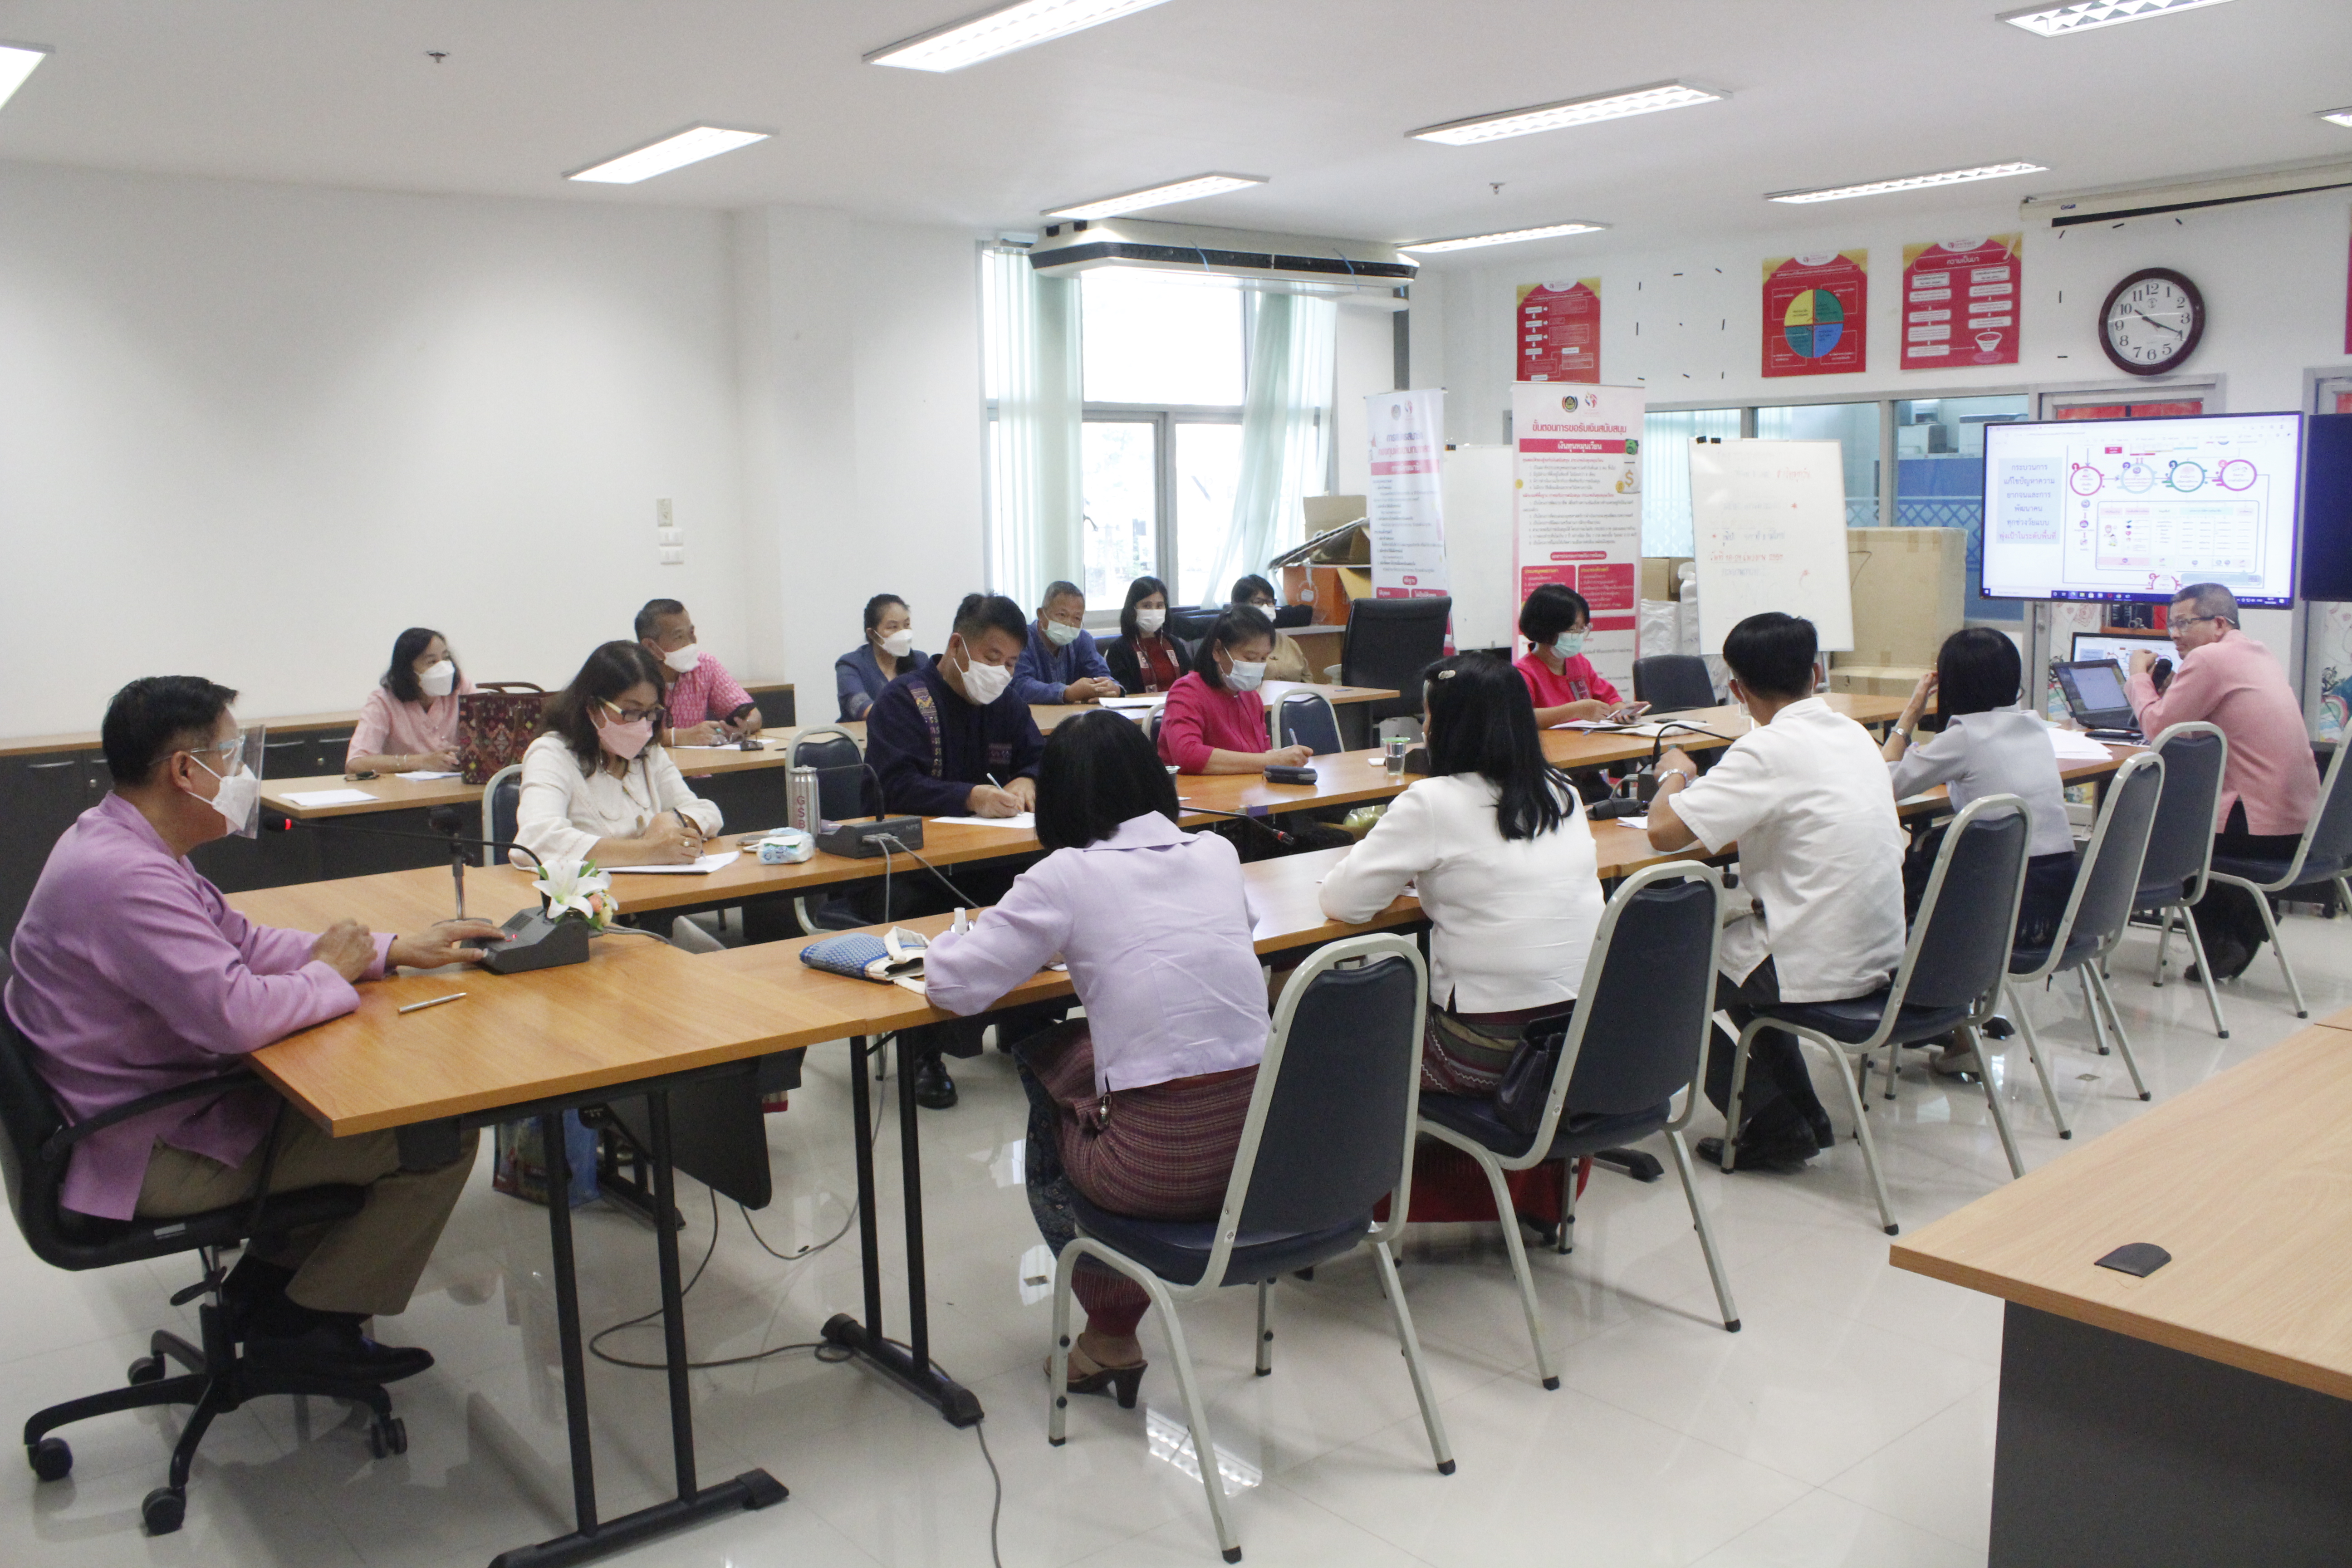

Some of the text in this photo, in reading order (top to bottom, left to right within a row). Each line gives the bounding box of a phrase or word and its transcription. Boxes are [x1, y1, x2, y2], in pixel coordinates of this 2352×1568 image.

[2146, 283, 2159, 295] 12
[2166, 286, 2171, 297] 1
[2133, 290, 2142, 301] 11
[2177, 297, 2185, 308] 2
[2120, 304, 2132, 314] 10
[2181, 313, 2190, 323] 3
[2115, 320, 2124, 330] 9
[2120, 335, 2128, 346] 8
[2175, 330, 2183, 341] 4
[2133, 347, 2142, 358] 7
[2147, 349, 2156, 360] 6
[2162, 343, 2171, 355] 5
[1558, 441, 1602, 452] เงินทุนหมุนเวียน
[796, 796, 805, 828] GSB
